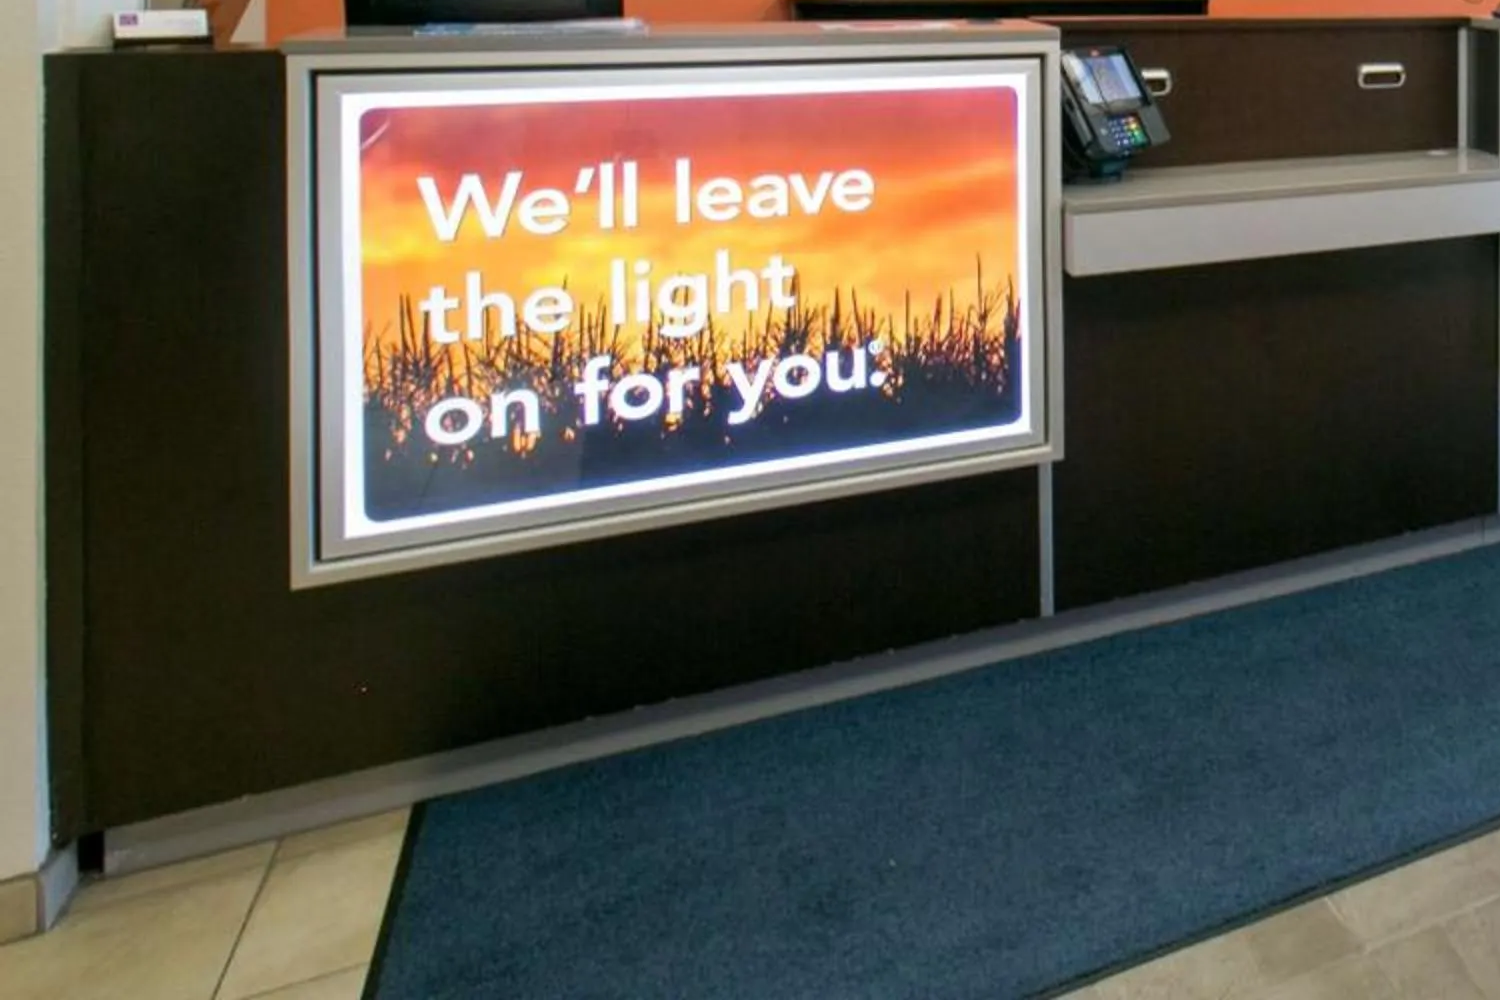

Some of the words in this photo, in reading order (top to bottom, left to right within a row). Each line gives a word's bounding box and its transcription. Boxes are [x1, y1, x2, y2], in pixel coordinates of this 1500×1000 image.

[416, 161, 639, 242] We'll
[675, 157, 876, 224] leave
[417, 270, 575, 343] the
[611, 248, 797, 339] light
[423, 381, 541, 446] on
[573, 355, 704, 427] for
